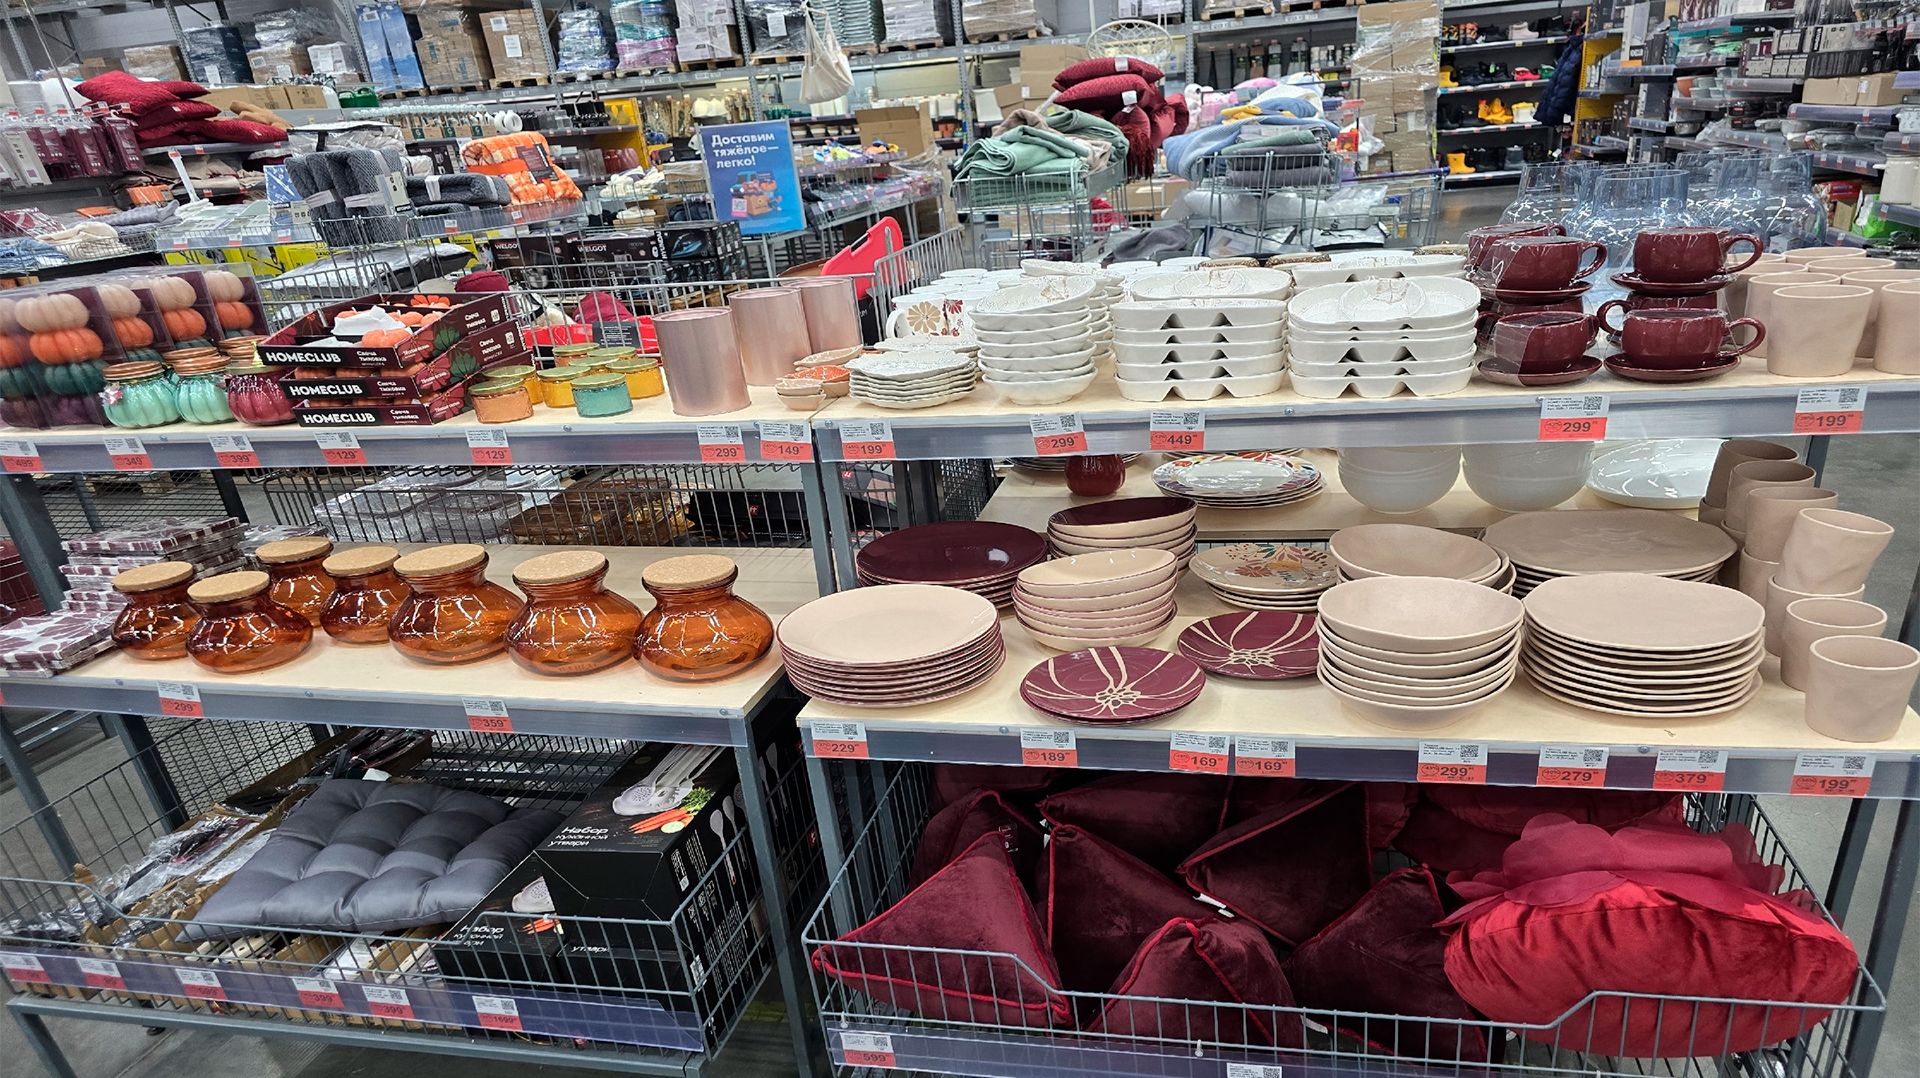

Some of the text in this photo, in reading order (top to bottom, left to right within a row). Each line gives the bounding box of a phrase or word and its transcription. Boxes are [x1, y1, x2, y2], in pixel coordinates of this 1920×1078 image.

[711, 133, 775, 147] Доставим
[716, 155, 756, 169] легко!
[265, 352, 341, 363] HOMECLUB
[289, 384, 363, 396] HOMECLUB
[303, 412, 376, 424] HOMECLUB
[1816, 415, 1846, 426] 199
[1562, 422, 1591, 432] 299
[1051, 437, 1075, 448] 299
[1166, 435, 1192, 445] 449
[715, 448, 737, 457] 299
[777, 445, 799, 455] 149
[860, 444, 882, 454] 199
[230, 454, 250, 463] 399
[336, 451, 356, 459] 129
[486, 450, 505, 459] 129
[124, 457, 143, 466] 349
[174, 702, 193, 712] 299
[482, 719, 504, 728] 359
[831, 743, 855, 752] 229
[1041, 752, 1065, 761] 189
[1191, 756, 1217, 766] 169
[1254, 759, 1281, 770] 169
[1440, 766, 1468, 776] 299
[1561, 771, 1592, 781] 279
[1675, 774, 1707, 783] 379
[1819, 779, 1849, 789] 199
[561, 826, 609, 835] Набор
[312, 994, 332, 1003] 399
[384, 1006, 404, 1014] 399
[863, 1054, 886, 1062] 599
